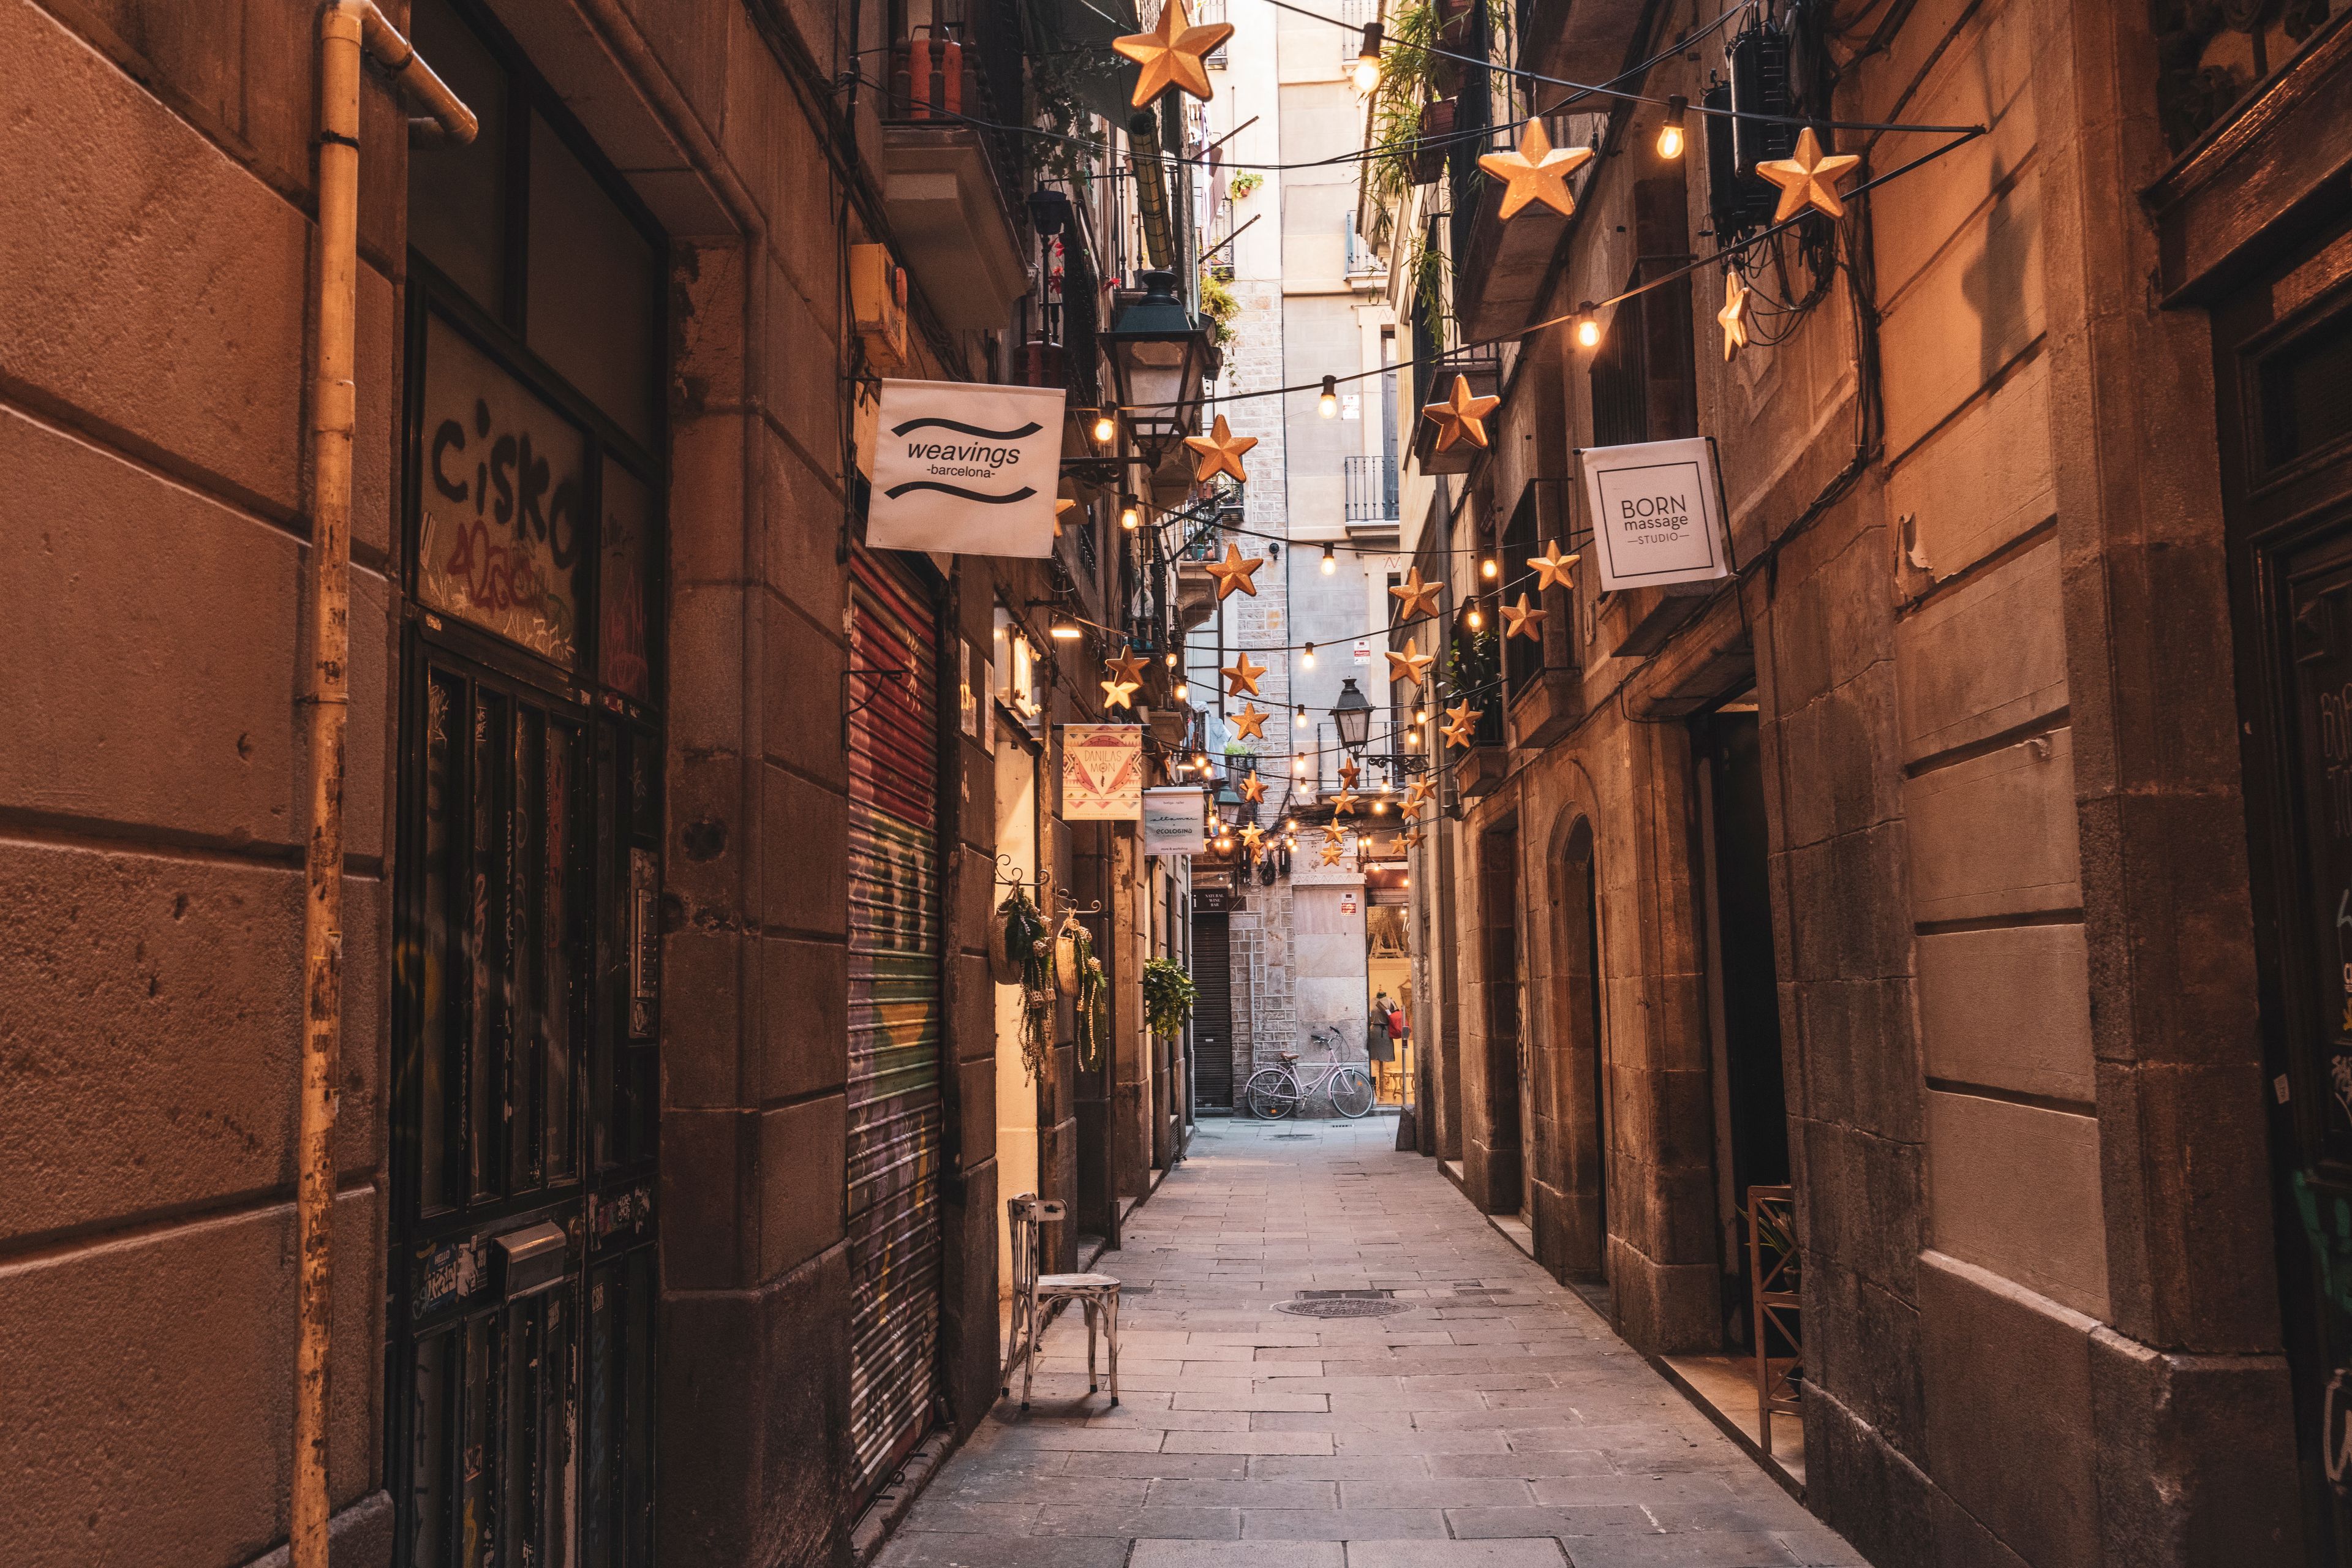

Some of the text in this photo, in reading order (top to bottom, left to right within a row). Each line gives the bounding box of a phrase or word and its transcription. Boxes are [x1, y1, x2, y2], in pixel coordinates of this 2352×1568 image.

[908, 442, 1020, 469] weavings
[1621, 494, 1686, 519] BORN
[1624, 516, 1688, 530] massage
[1084, 750, 1122, 763] DANILAS
